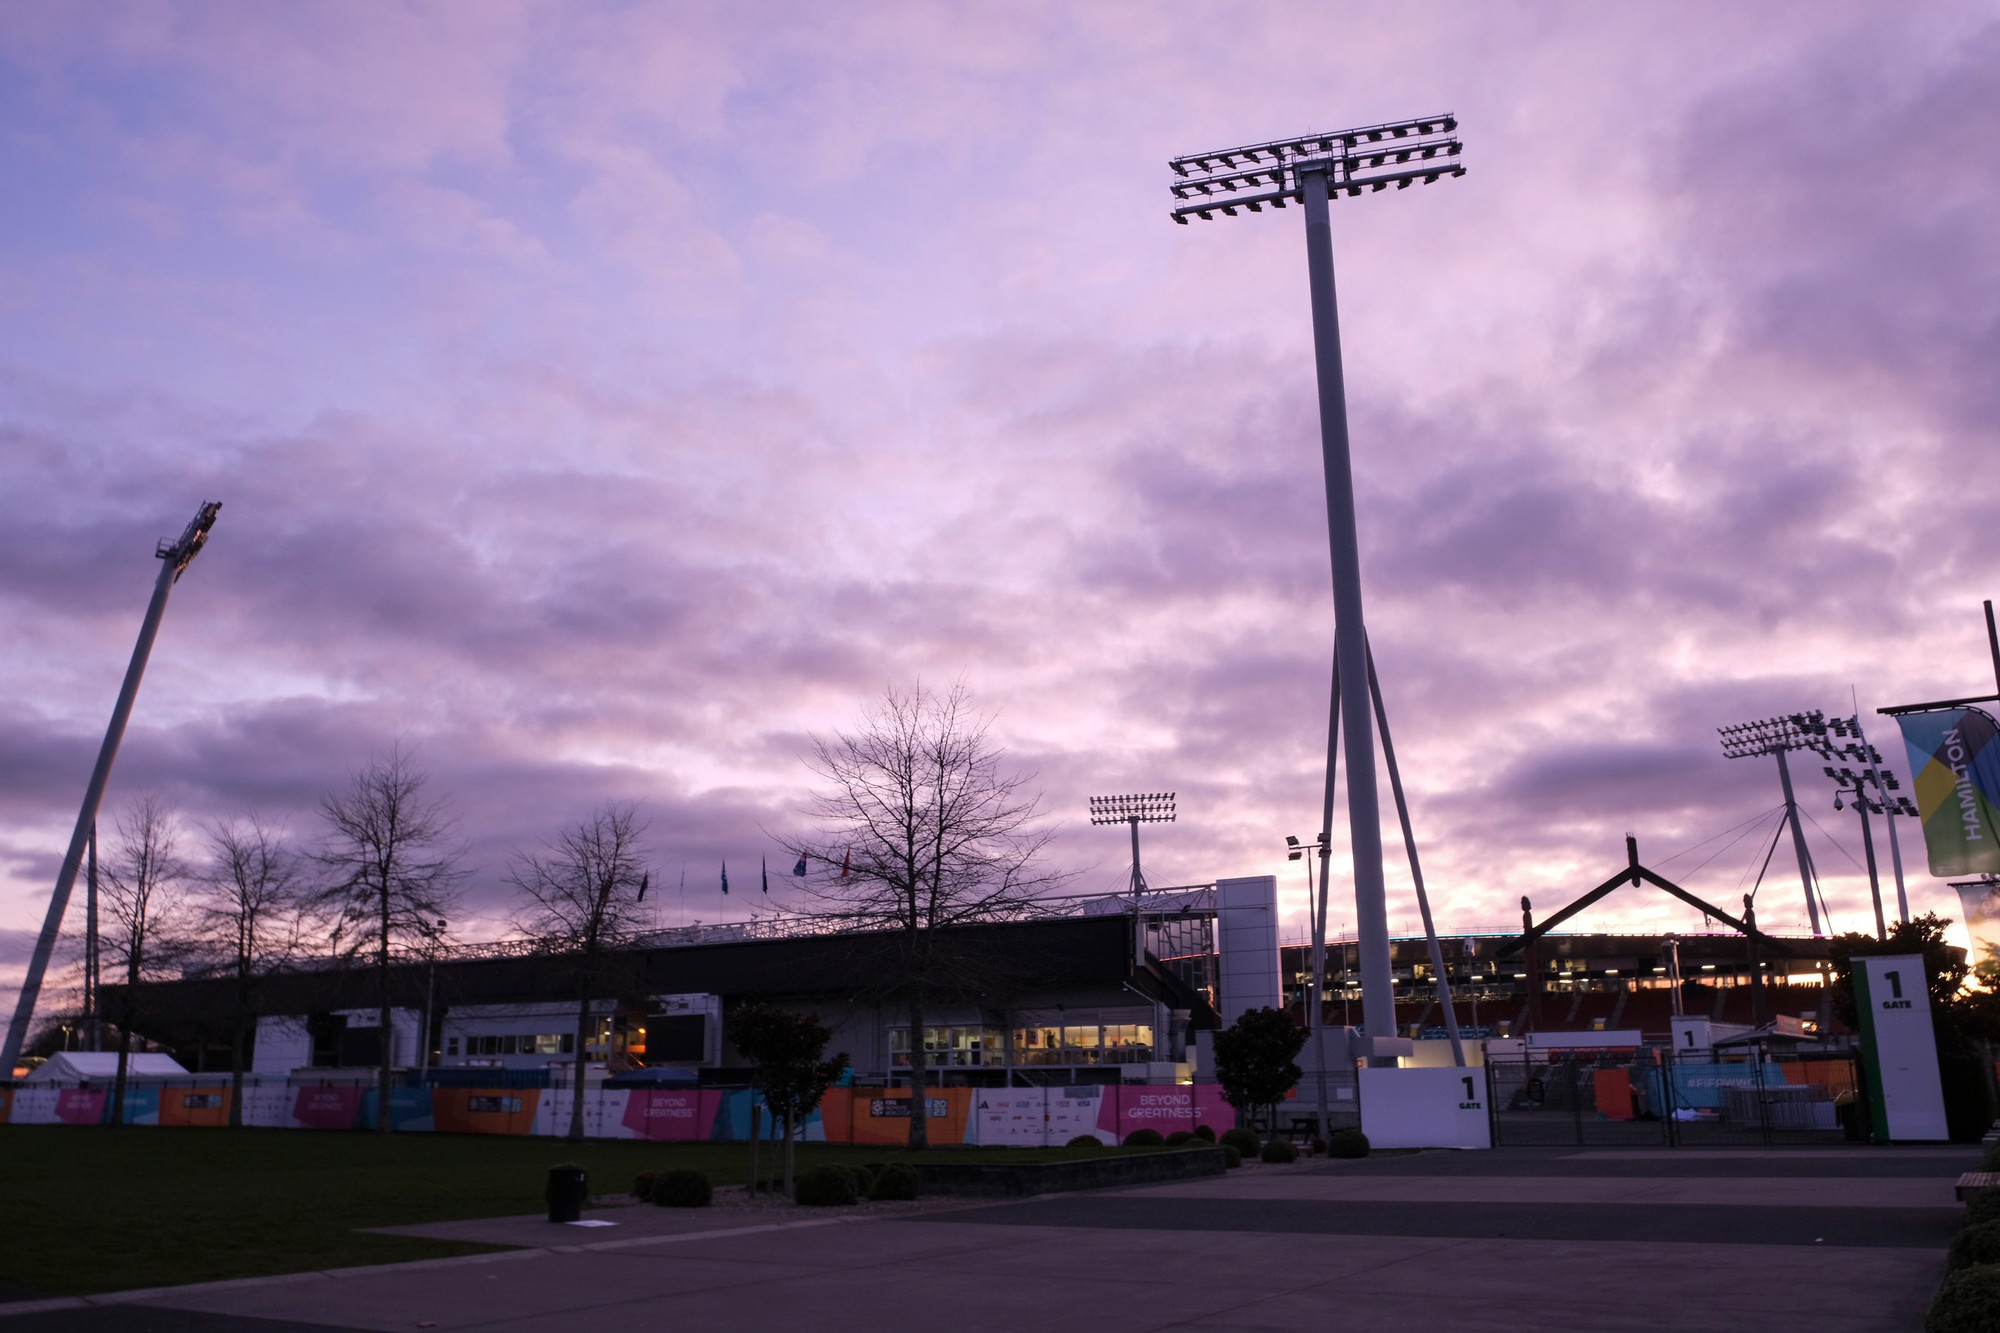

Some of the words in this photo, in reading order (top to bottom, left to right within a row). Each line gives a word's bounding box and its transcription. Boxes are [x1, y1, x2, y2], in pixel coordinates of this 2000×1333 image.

[1942, 727, 1983, 841] HAMILTON
[1884, 971, 1902, 998] 1
[1883, 1001, 1912, 1009] GATE
[1684, 1031, 1694, 1047] 1
[1462, 1076, 1474, 1100] 1
[653, 1098, 687, 1107] BEYOND
[1140, 1095, 1190, 1106] BEYOND
[1128, 1107, 1202, 1118] GREATNESS
